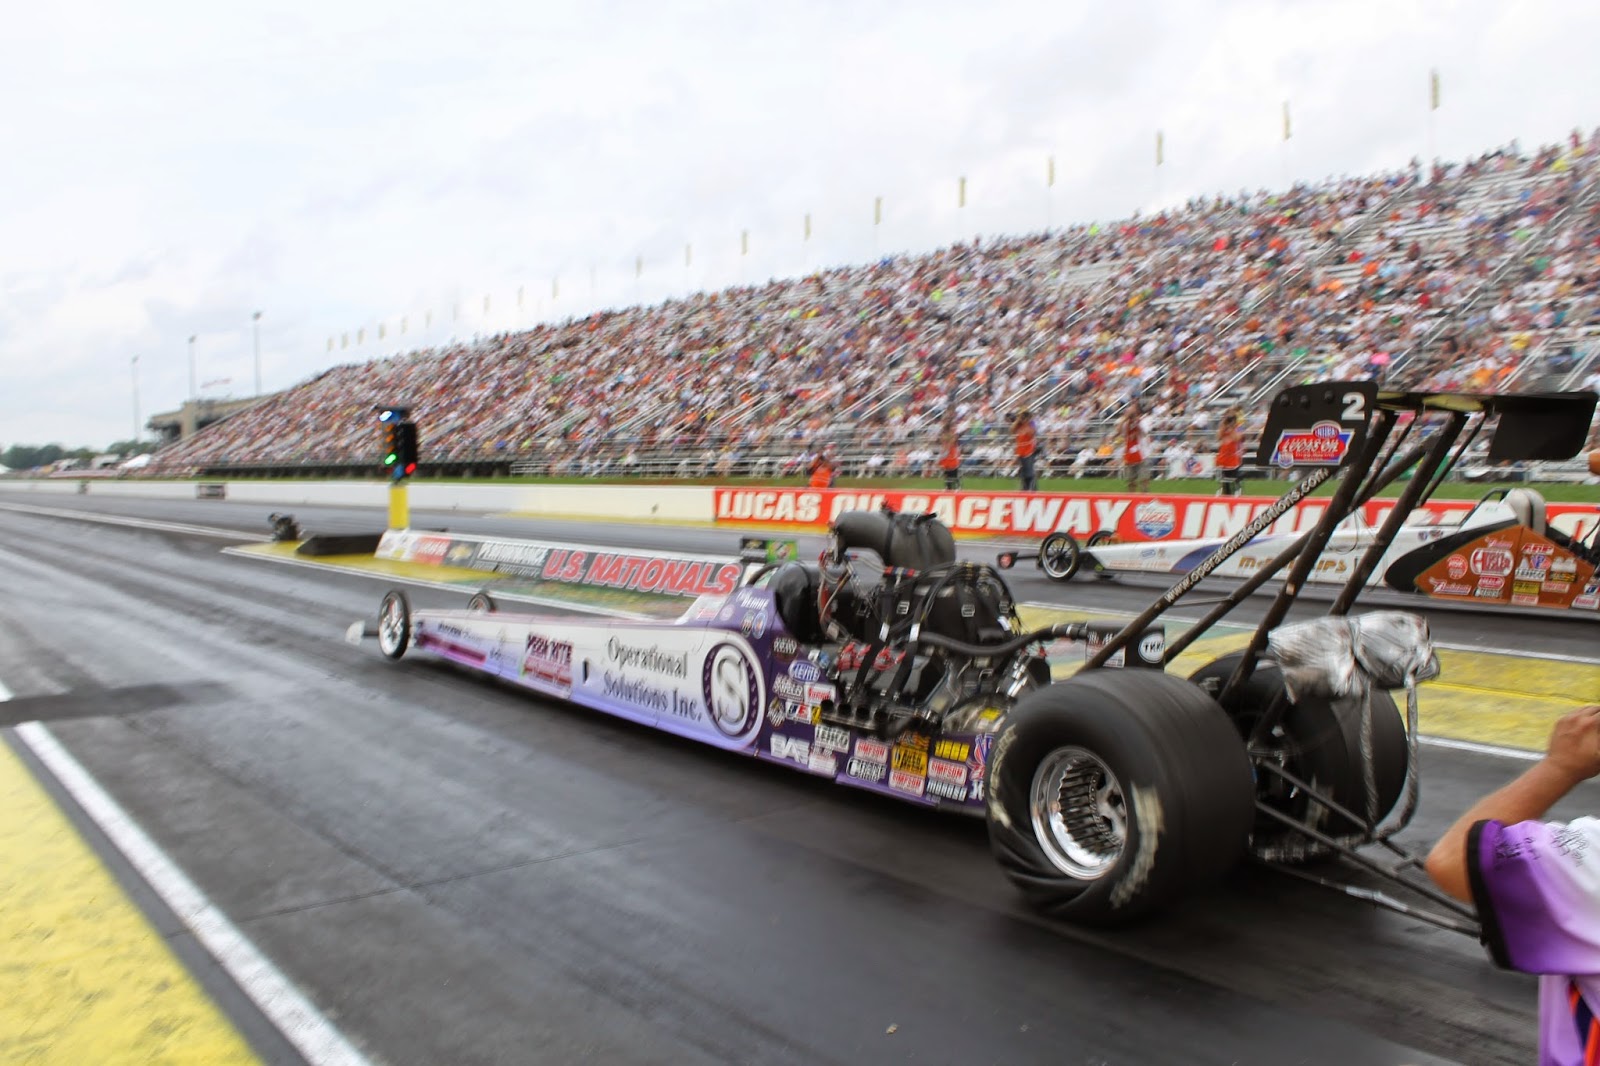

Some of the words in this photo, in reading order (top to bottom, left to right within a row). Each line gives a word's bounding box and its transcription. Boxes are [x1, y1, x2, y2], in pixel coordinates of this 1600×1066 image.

[1341, 392, 1366, 421] 2
[1282, 438, 1322, 453] LUCAS
[1323, 439, 1340, 453] OIL
[718, 491, 822, 522] LUCAS
[900, 495, 1131, 534] RACEWAY
[1164, 467, 1330, 603] www.operationalsolutions.com
[543, 549, 588, 581] U.S.
[584, 552, 743, 599] NATIONALS
[607, 635, 689, 680] Operational
[602, 671, 669, 712] Solutions
[672, 687, 702, 723] Inc.
[857, 739, 886, 757] SIMPSON
[892, 771, 921, 788] SIMPSON
[931, 760, 964, 778] SIMPSON
